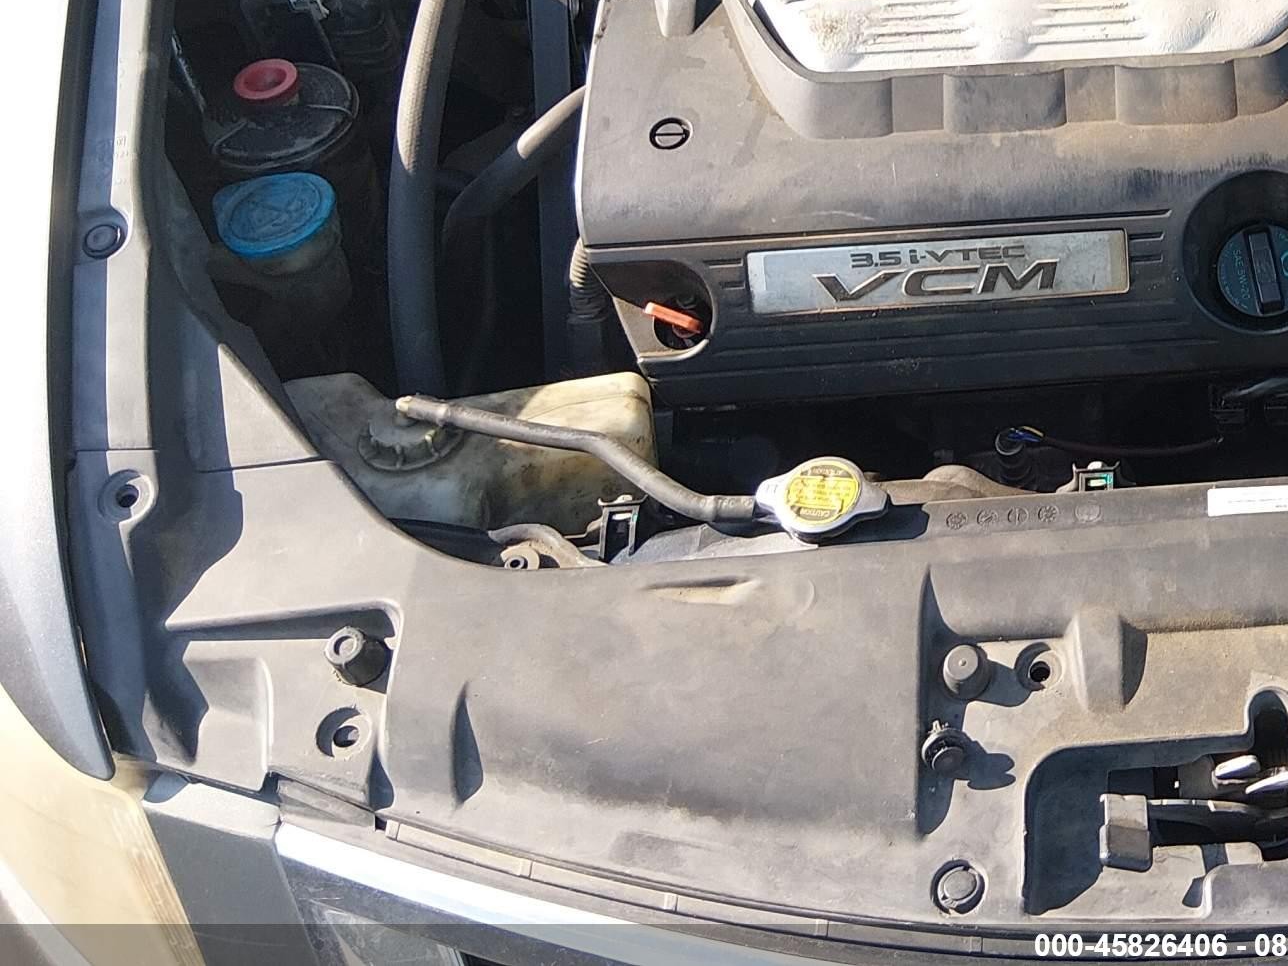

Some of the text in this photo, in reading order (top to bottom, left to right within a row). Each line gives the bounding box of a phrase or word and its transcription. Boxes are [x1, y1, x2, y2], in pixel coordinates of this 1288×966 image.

[850, 244, 1027, 268] 3.5 i-VTEC
[1233, 250, 1244, 267] SAE
[813, 259, 1060, 302] VCM
[799, 508, 830, 517] CAUTION
